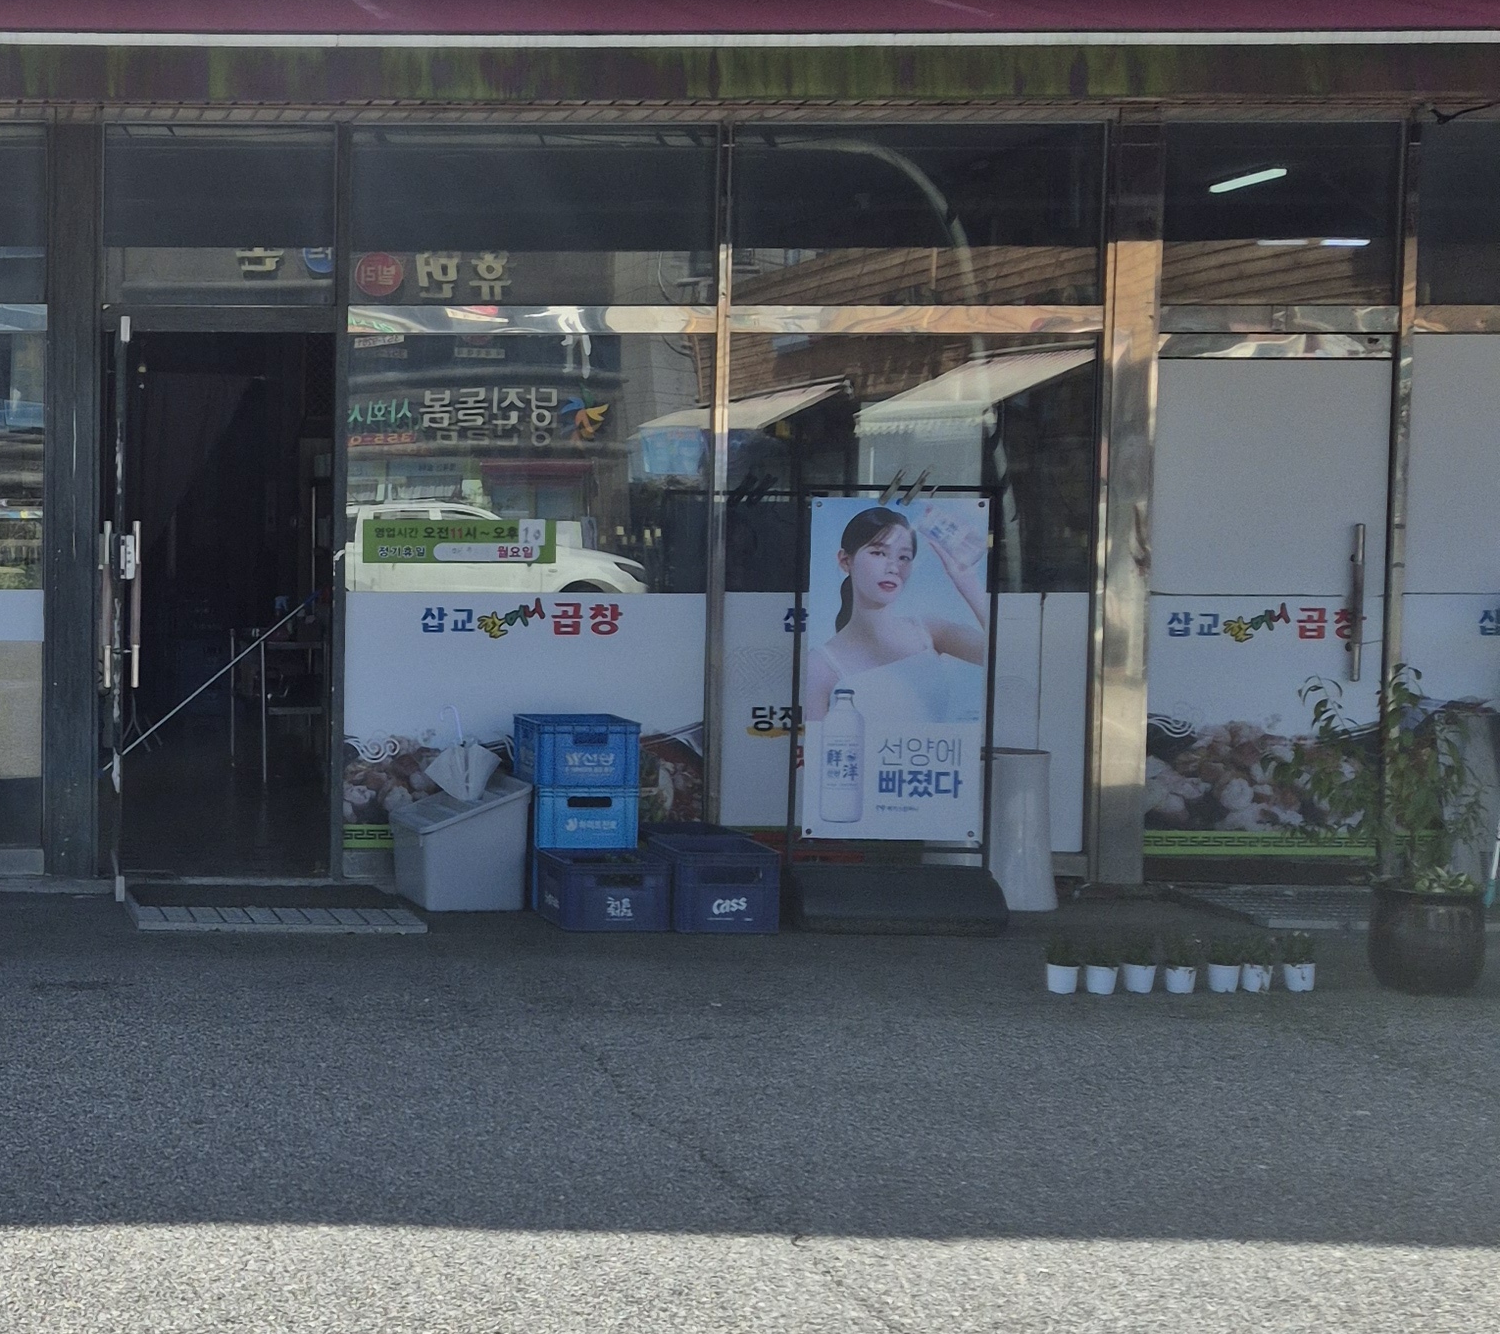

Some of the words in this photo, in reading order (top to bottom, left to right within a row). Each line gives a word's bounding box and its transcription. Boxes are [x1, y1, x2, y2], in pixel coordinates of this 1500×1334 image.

[374, 527, 419, 539] 영업시간
[493, 526, 518, 540] 오후
[378, 545, 426, 558] 정기휴일
[497, 545, 534, 559] 월요일
[421, 606, 475, 633] 삽교
[551, 602, 623, 636] 곱창
[1167, 610, 1220, 637] 삽교
[878, 737, 962, 767] 선양에
[878, 769, 963, 799] 빠졌다
